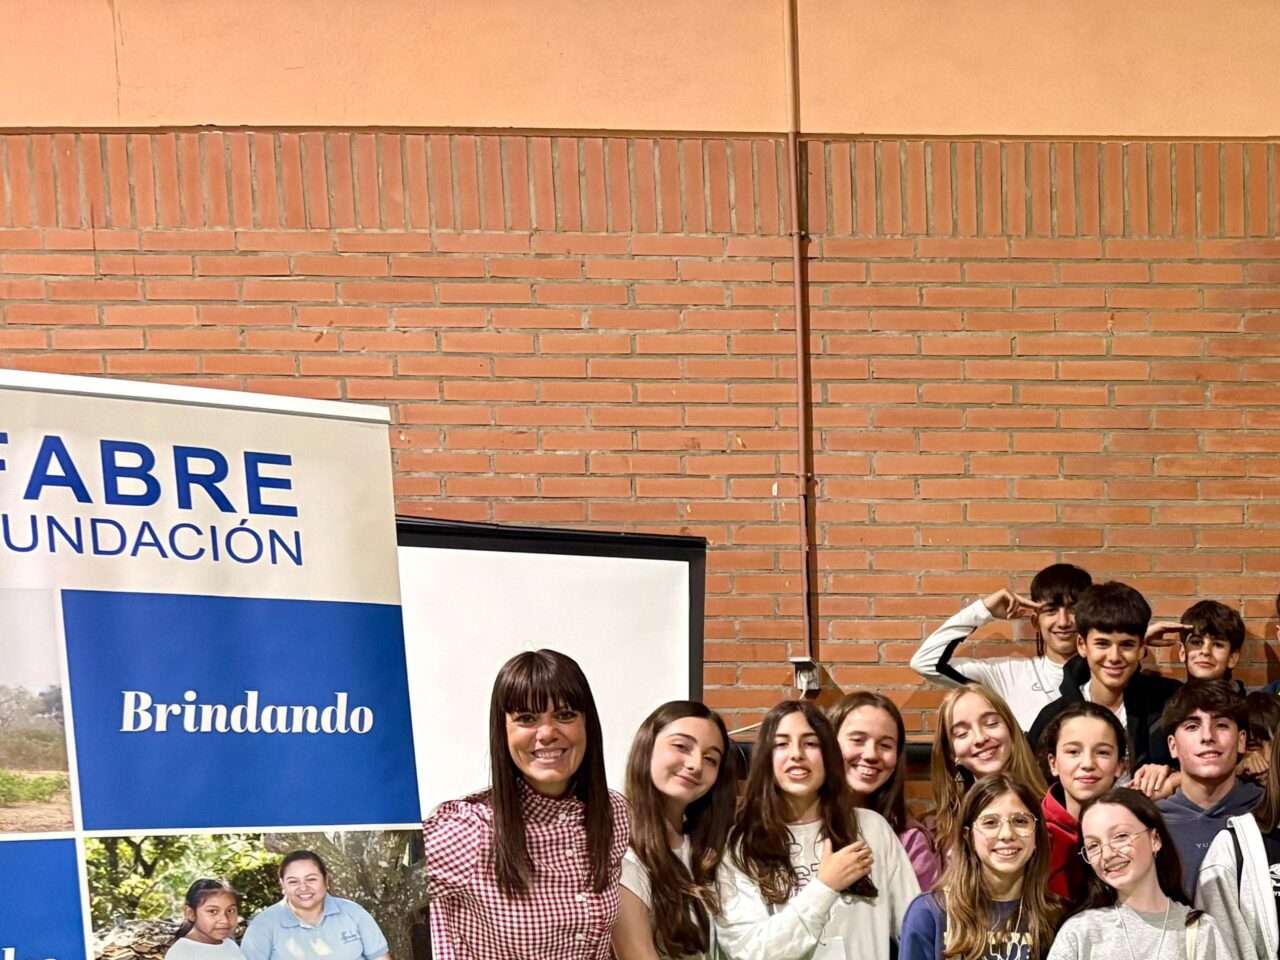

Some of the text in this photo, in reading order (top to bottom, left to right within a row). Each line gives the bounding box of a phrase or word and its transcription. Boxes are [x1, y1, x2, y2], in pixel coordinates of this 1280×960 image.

[0, 432, 299, 517] ABRE
[1, 513, 303, 566] UNDACIÓN
[119, 690, 375, 735] Brindando
